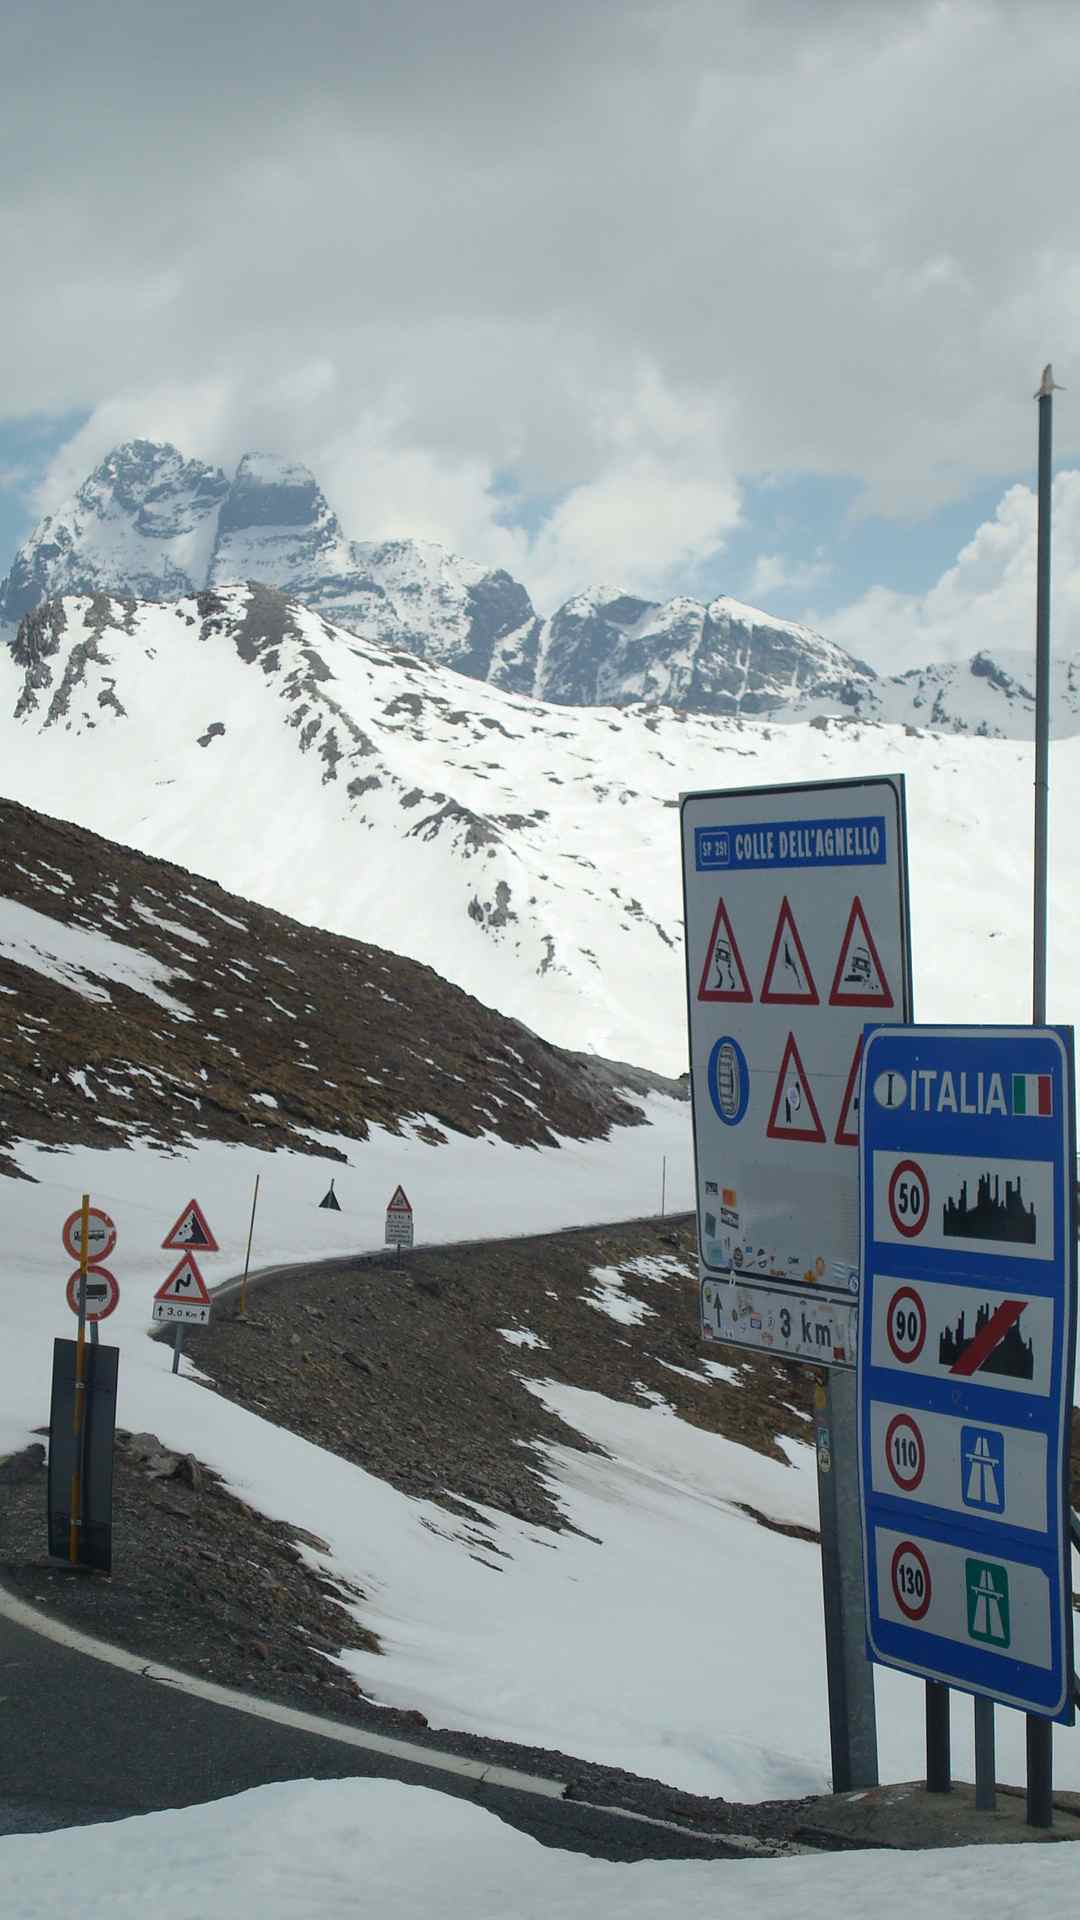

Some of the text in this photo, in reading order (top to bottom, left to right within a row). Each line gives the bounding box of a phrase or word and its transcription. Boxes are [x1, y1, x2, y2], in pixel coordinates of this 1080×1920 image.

[702, 825, 880, 860] SP 251 COLLE DELL'AGNELLO
[886, 1069, 1008, 1116] I ITALIA
[898, 1182, 921, 1215] 50
[780, 1308, 832, 1347] 3 km
[895, 1310, 919, 1343] 90
[893, 1436, 918, 1470] 110
[898, 1562, 924, 1598] 130
